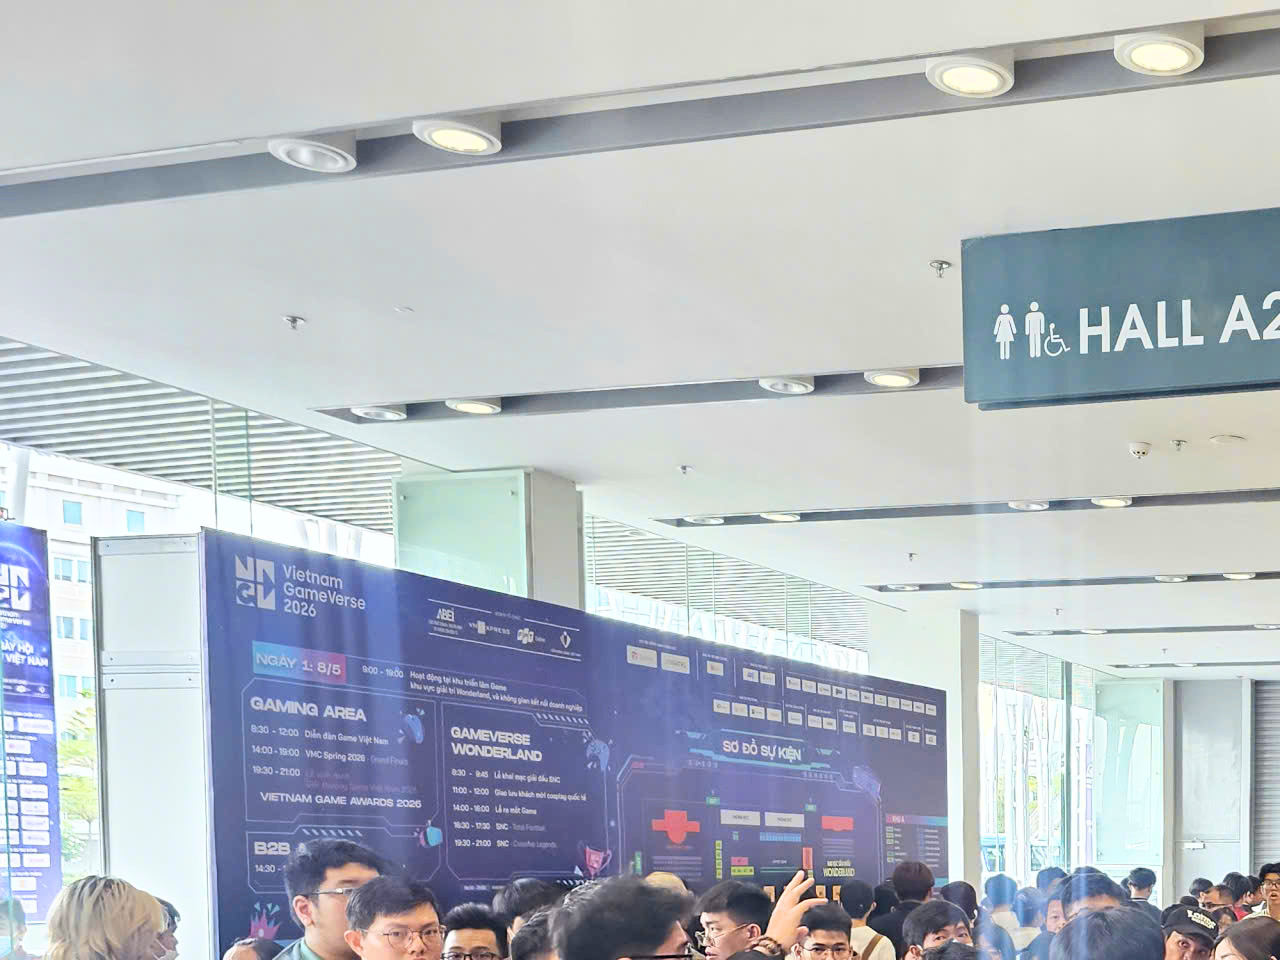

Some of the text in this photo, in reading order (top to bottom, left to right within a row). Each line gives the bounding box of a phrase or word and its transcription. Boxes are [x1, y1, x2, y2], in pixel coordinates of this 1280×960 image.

[1079, 299, 1205, 355] HALL
[283, 563, 343, 589] Vietnam
[283, 582, 366, 610] GameVerse
[283, 598, 317, 617] 2026
[317, 662, 341, 675] 8/5
[250, 696, 367, 722] GAMING AREA
[250, 724, 269, 734] 8:30
[279, 727, 299, 737] 12:00
[338, 734, 357, 743] Game
[358, 735, 373, 746] Việt
[373, 737, 389, 745] Nam
[450, 726, 531, 746] GAMEVERSE
[251, 745, 273, 754] 14:00
[305, 750, 323, 759] VMC
[323, 751, 346, 763] Spring
[451, 742, 543, 762] WONDERLAND
[279, 767, 300, 777] 21:00
[260, 791, 422, 809] VIETNAM GAME AWARDS 2026
[254, 841, 291, 855] B2B
[255, 864, 276, 873] 14:30
